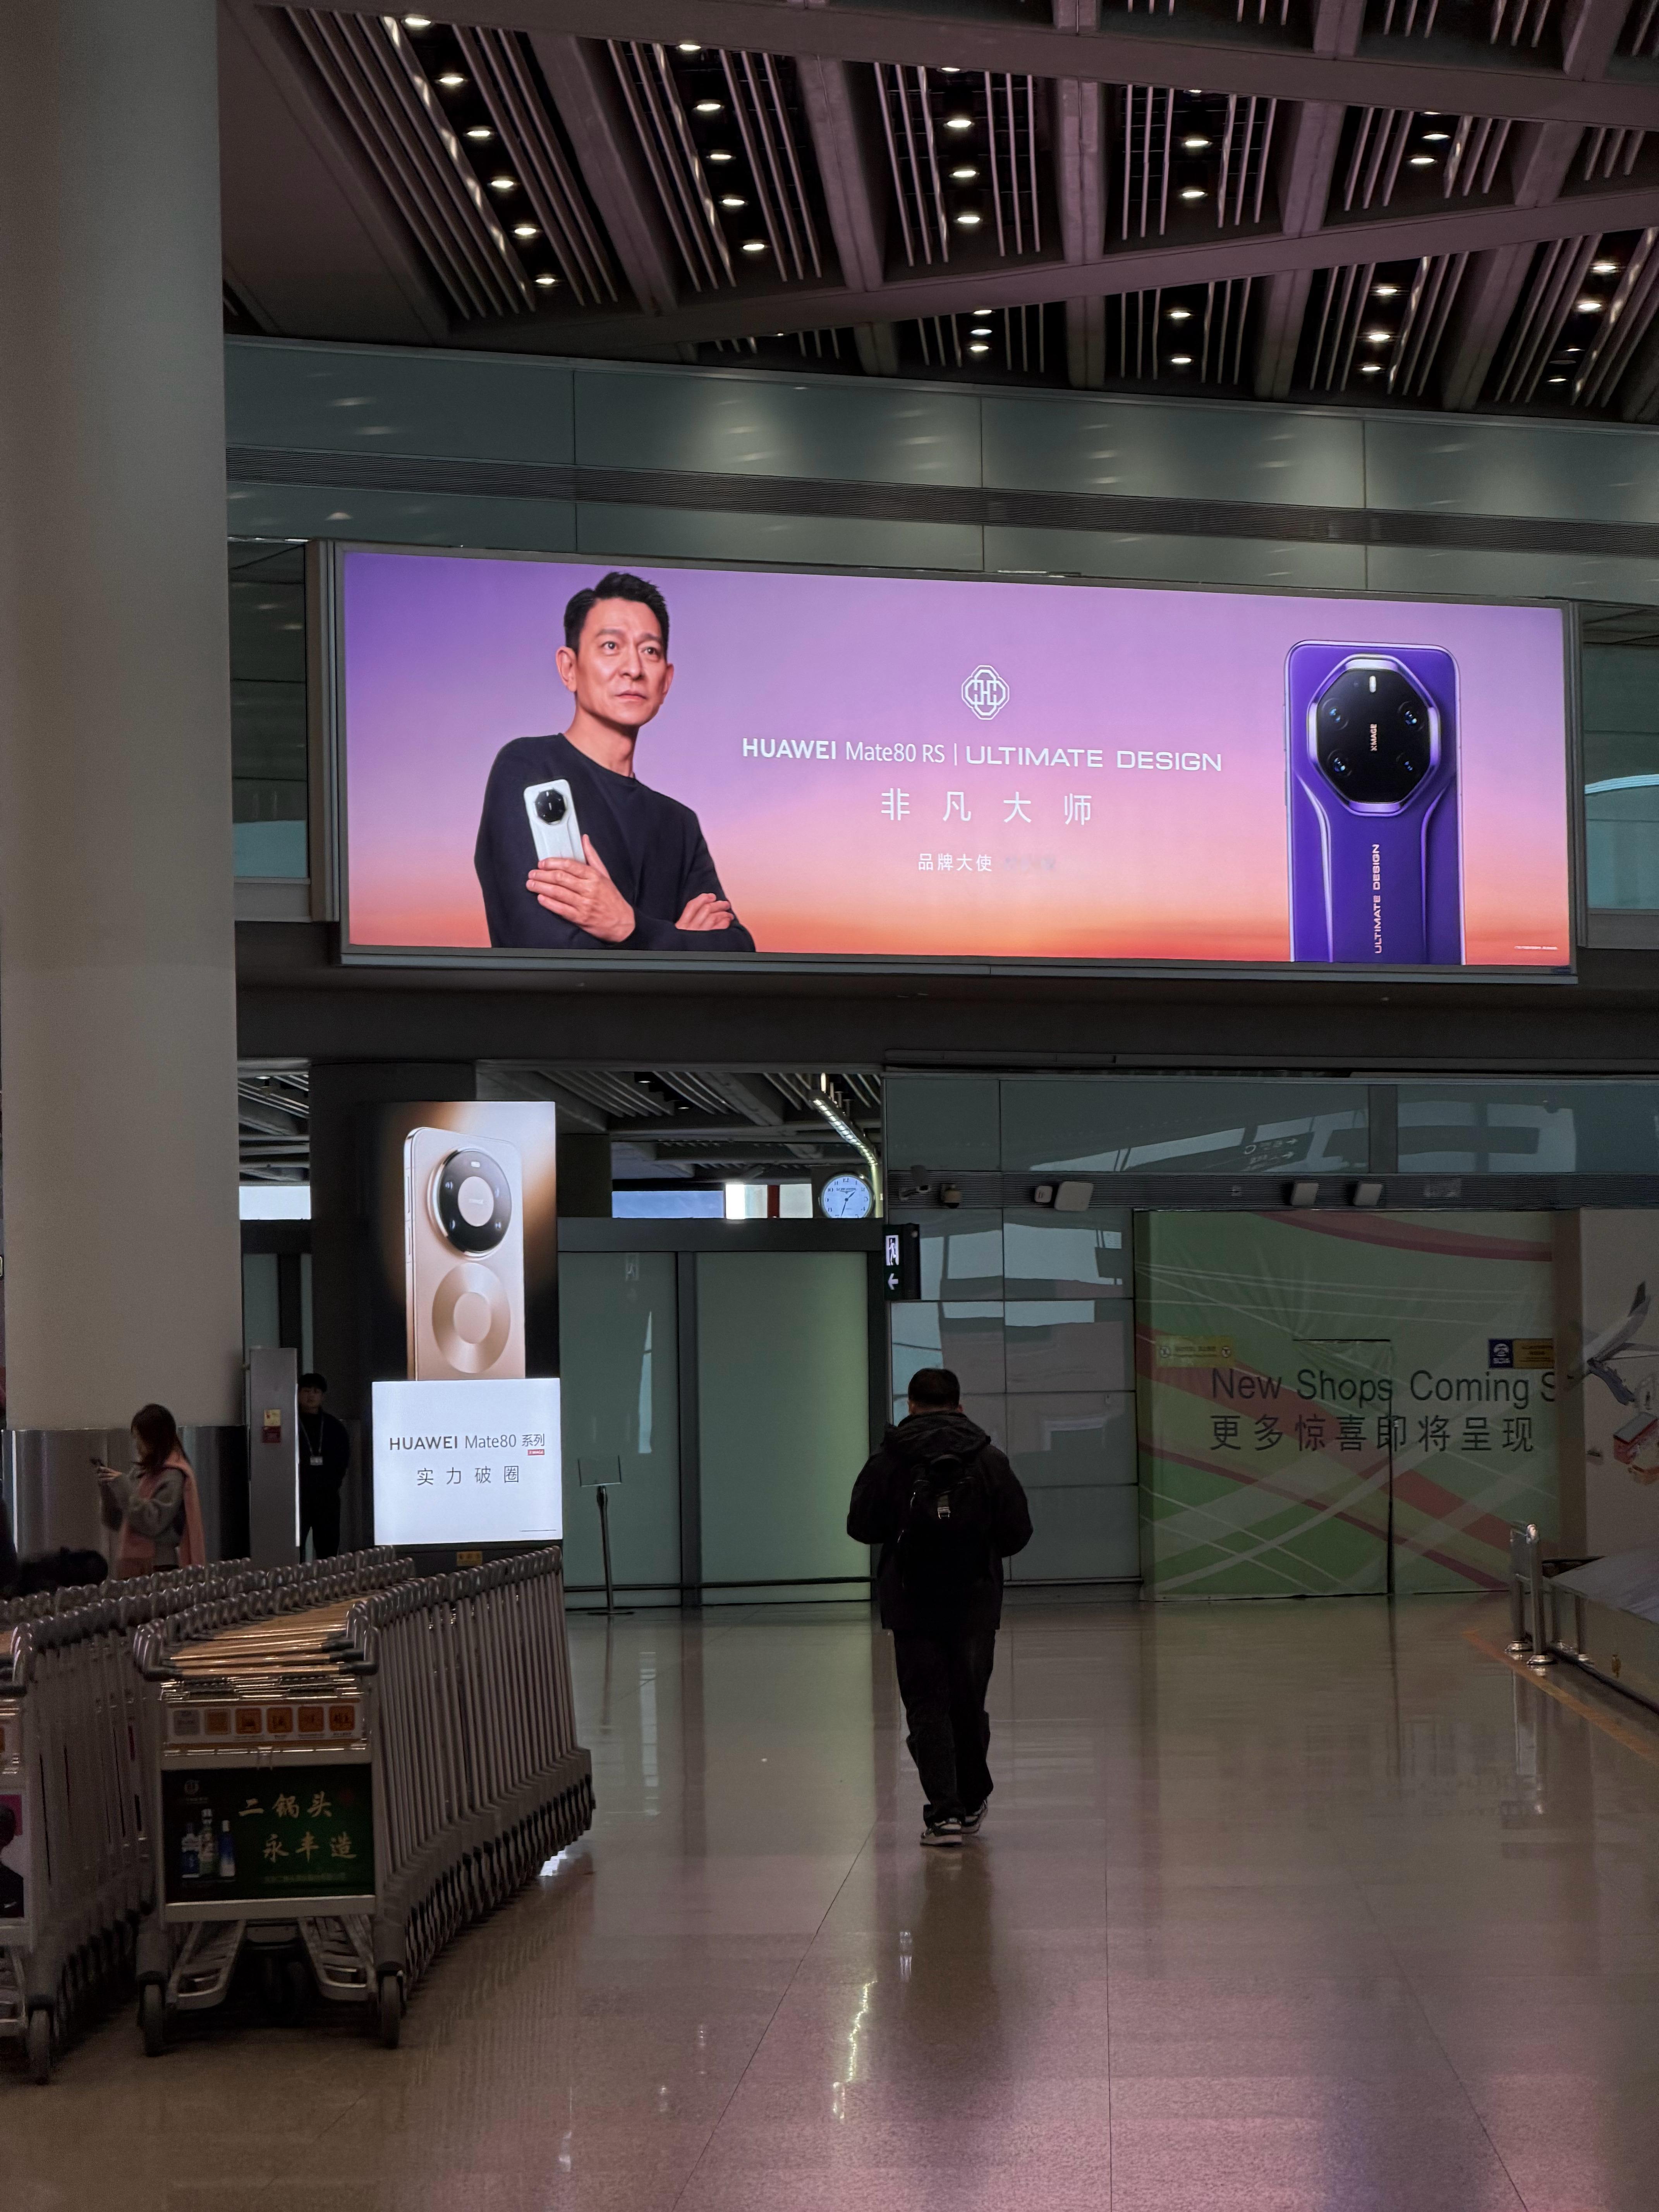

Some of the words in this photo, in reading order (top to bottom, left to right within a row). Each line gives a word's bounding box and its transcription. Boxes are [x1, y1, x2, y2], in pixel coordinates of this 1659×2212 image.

[742, 738, 836, 759] HUAWEI
[846, 741, 917, 763] Mate80
[922, 744, 945, 763] RS
[966, 746, 1103, 767] ULTIMATE
[1116, 750, 1222, 771] DESIGN
[881, 788, 1092, 825] 非凡大师
[918, 853, 992, 872] 品牌大使
[1372, 844, 1380, 890] DESIGN
[1373, 895, 1382, 954] ULTIMATE
[1212, 1367, 1282, 1399] New
[1297, 1368, 1392, 1409] Shops
[1410, 1369, 1529, 1410] Coming
[389, 1436, 458, 1451] HUAWEI
[465, 1434, 517, 1449] Mate80
[521, 1433, 545, 1447] 系列
[1210, 1414, 1534, 1453] 更多惊喜即将呈现
[417, 1465, 519, 1486] 实力破圈
[238, 1790, 333, 1819] 二锅头
[263, 1831, 357, 1863] 永丰造
